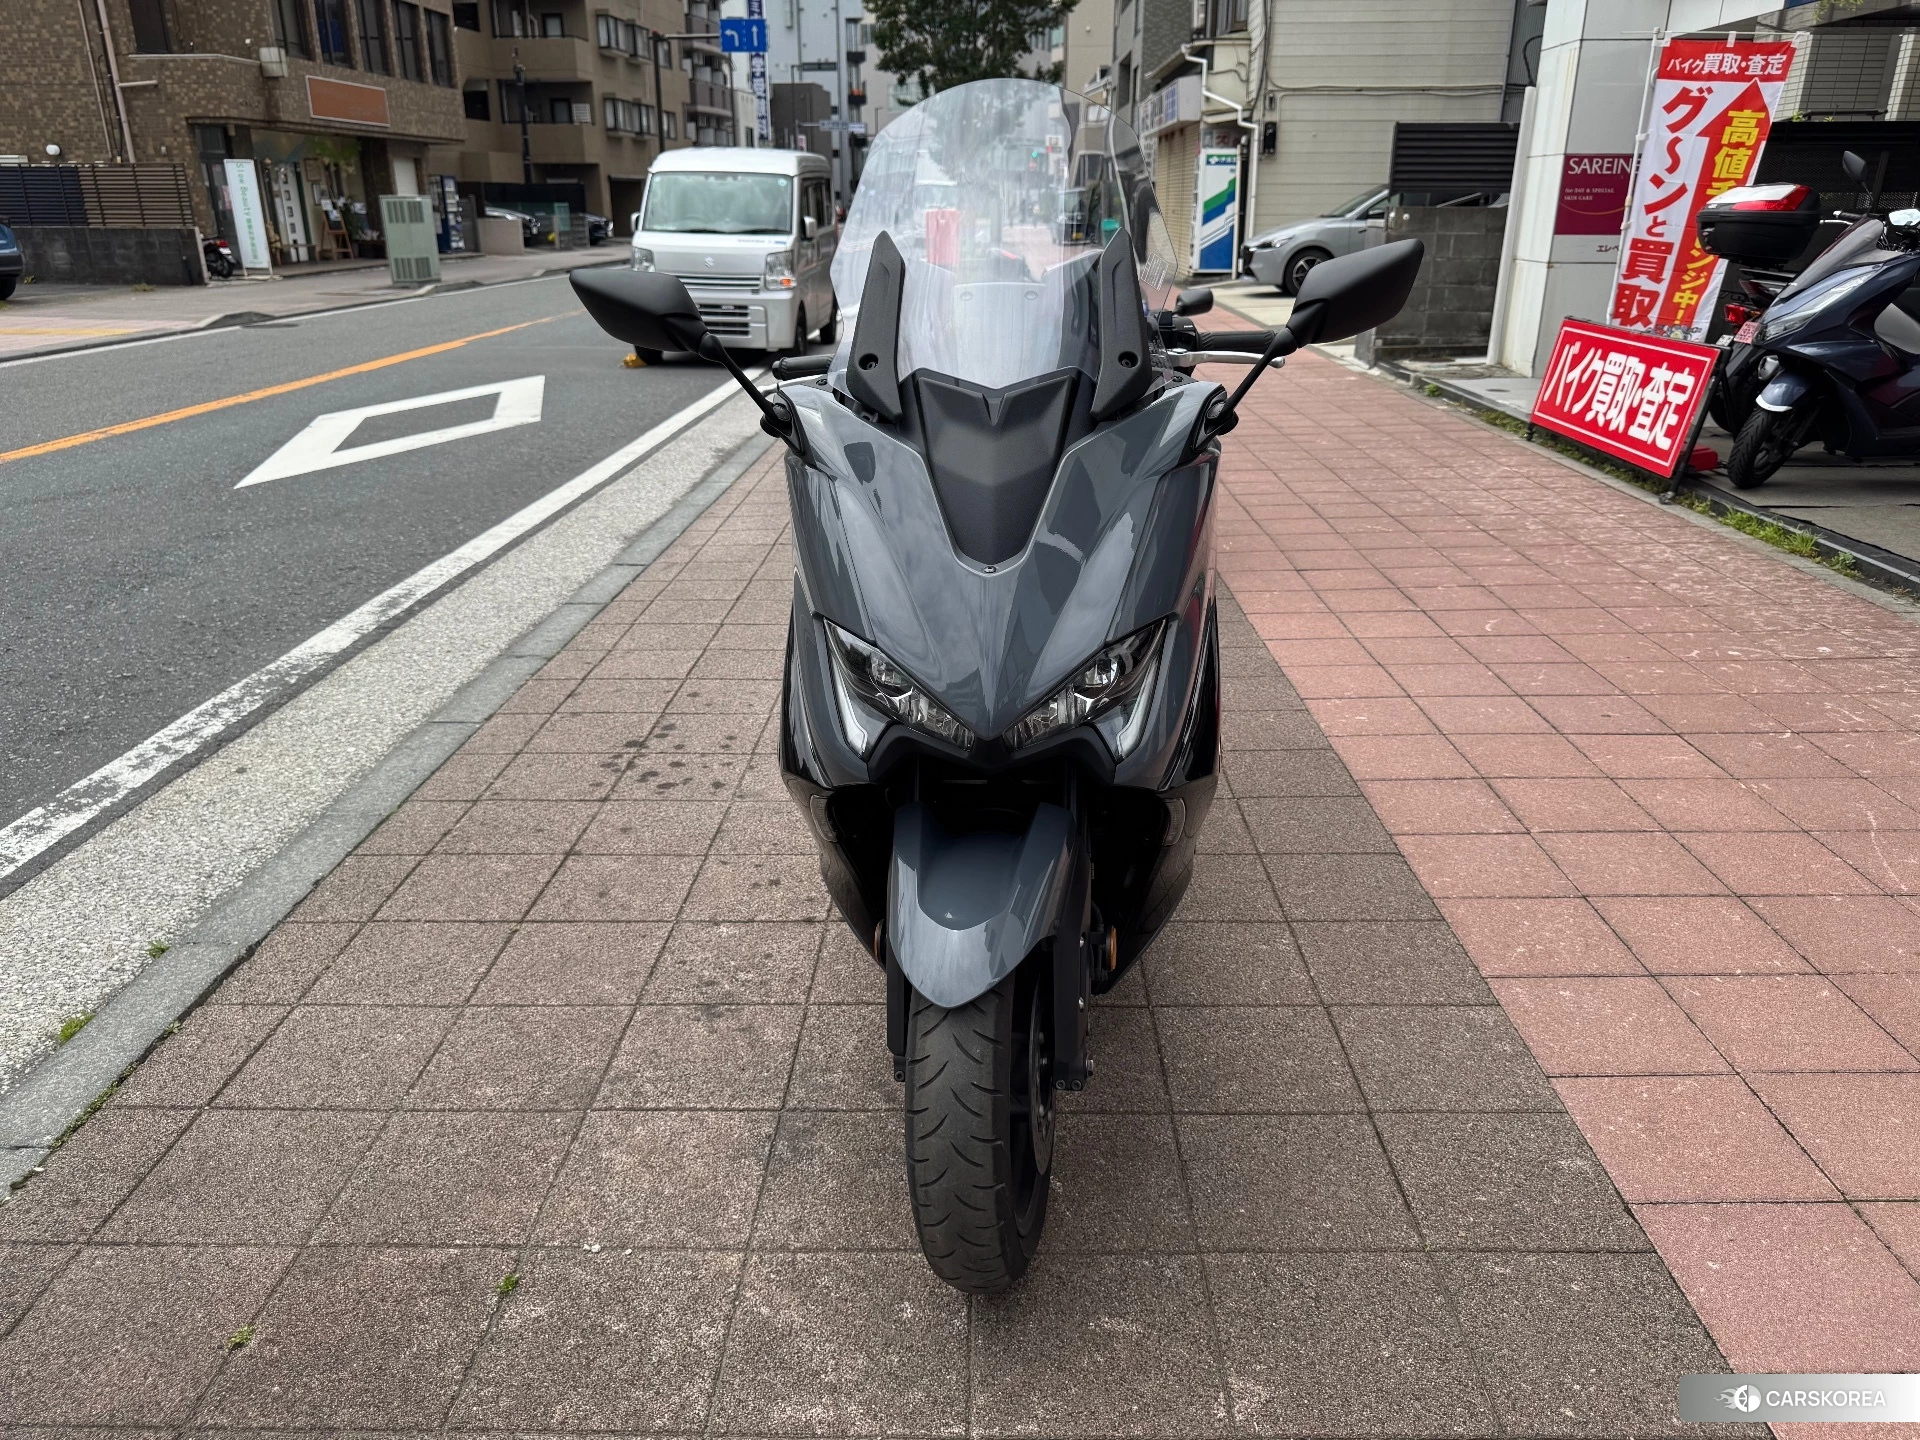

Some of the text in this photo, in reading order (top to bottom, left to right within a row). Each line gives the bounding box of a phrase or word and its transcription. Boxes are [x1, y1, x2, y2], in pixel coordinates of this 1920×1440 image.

[1667, 53, 1787, 75] バイク買取・査定
[1543, 341, 1695, 450] バイク買取・査定
